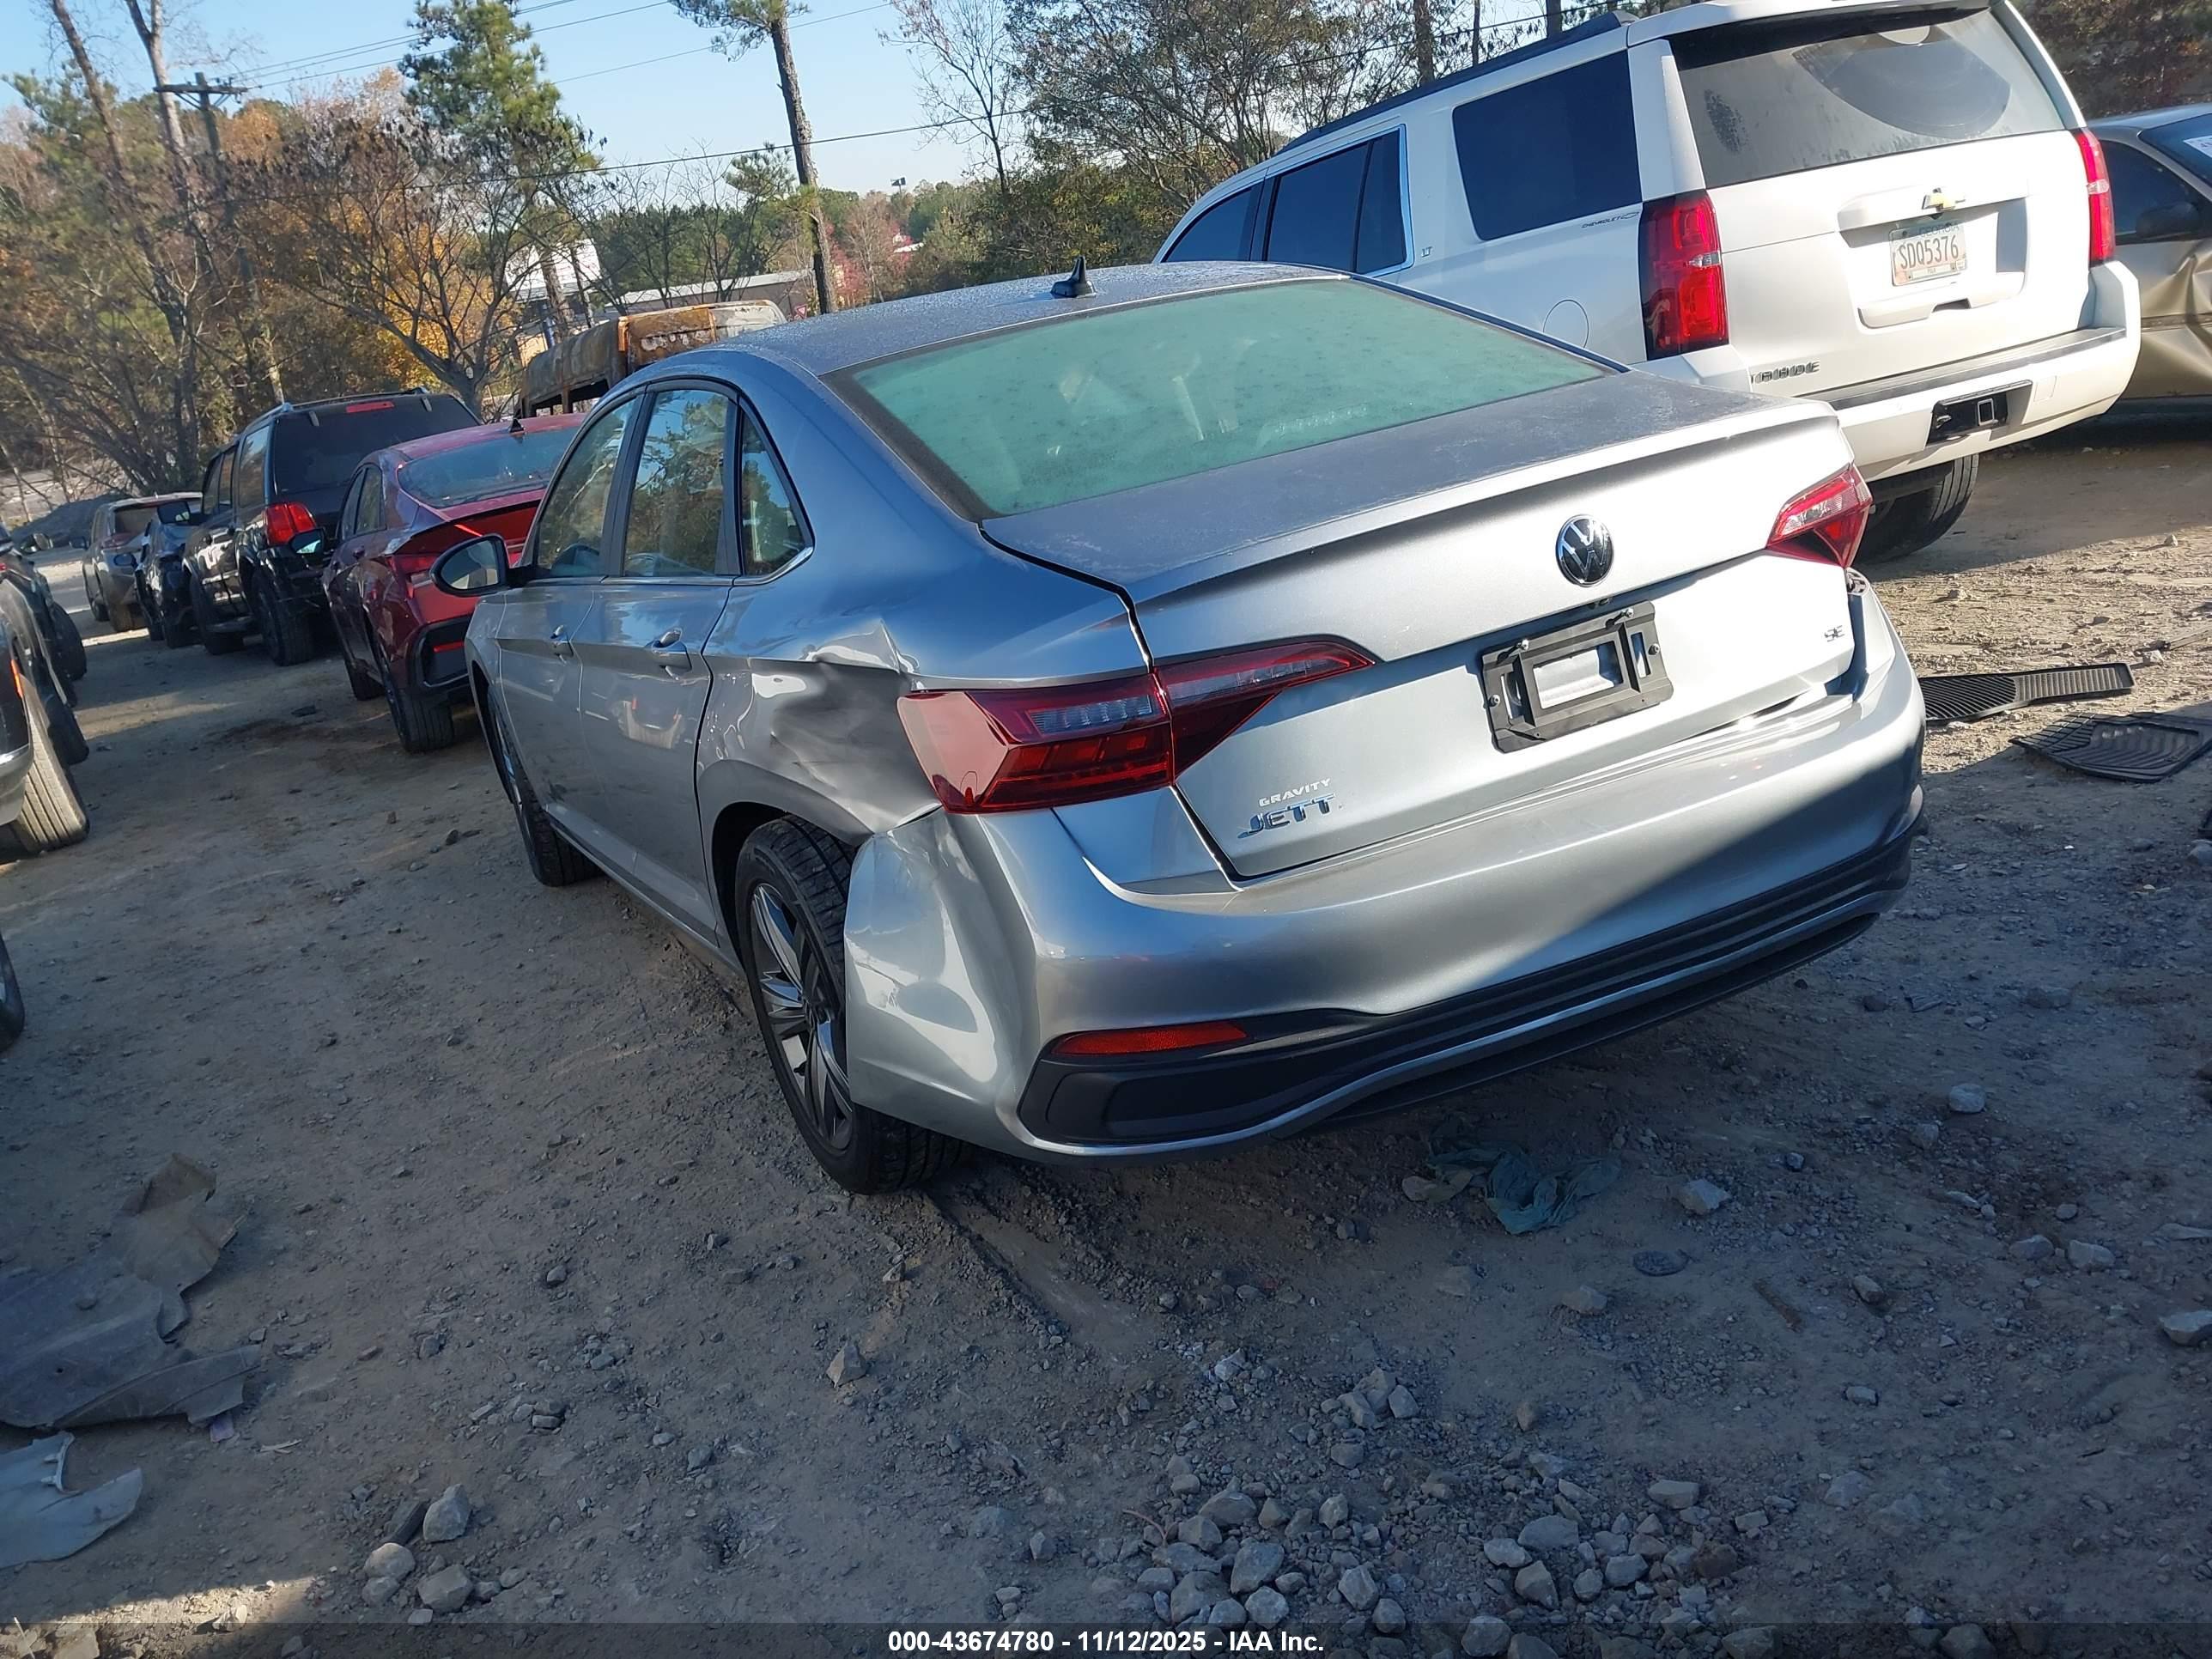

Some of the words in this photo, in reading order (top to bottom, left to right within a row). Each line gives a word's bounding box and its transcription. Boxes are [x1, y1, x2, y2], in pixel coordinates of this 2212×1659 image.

[1582, 215, 1621, 229] CHEVROLET
[1898, 234, 1959, 270] SDQ5376
[1258, 777, 1331, 807] GRAVITY
[1237, 792, 1336, 839] JETT
